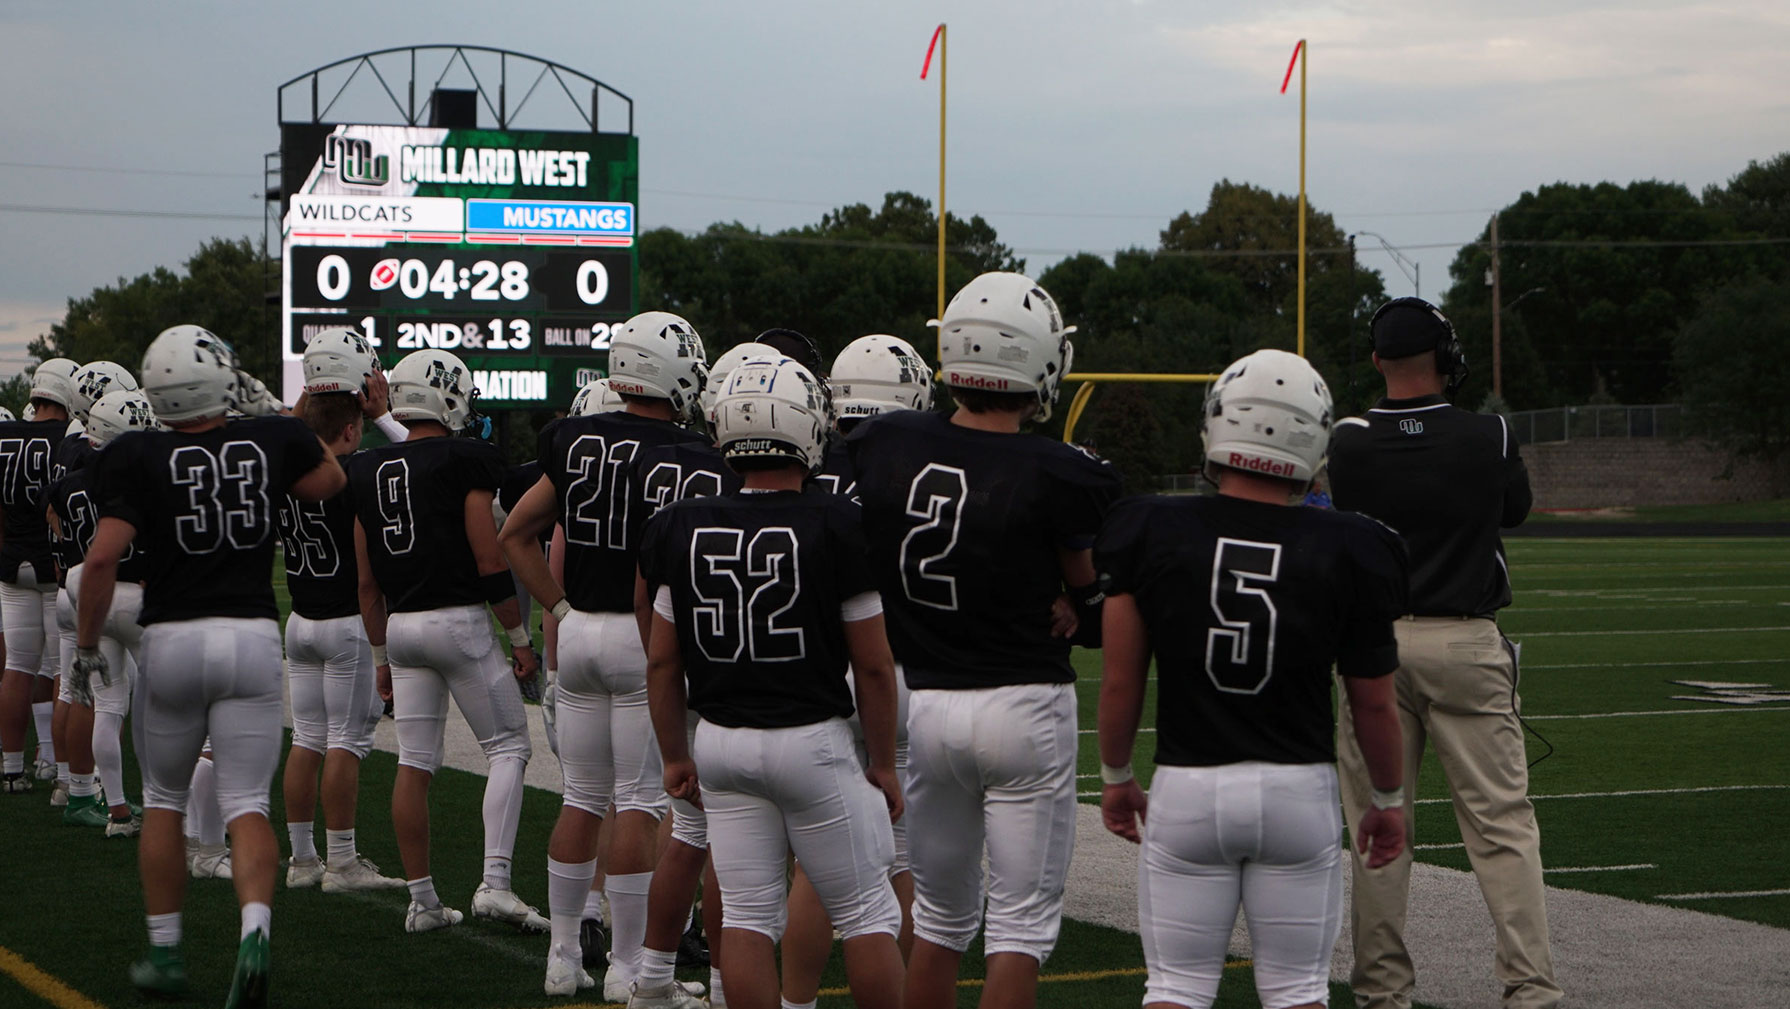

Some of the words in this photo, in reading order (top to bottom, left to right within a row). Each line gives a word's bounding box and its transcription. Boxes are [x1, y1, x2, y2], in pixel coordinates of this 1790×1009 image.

[401, 145, 517, 185] MILLARD
[518, 149, 591, 187] WEST
[299, 203, 413, 223] WILDCATS
[503, 206, 627, 230] MUSTANGS
[316, 254, 351, 300] 0
[399, 258, 530, 300] 04:28
[576, 259, 609, 305] 0
[360, 316, 382, 347] 1
[545, 328, 573, 346] BALL
[574, 328, 591, 347] ON
[307, 382, 340, 393] Riddell
[608, 381, 644, 394] Riddell
[950, 372, 1008, 390] Riddell
[844, 404, 880, 415] schutt
[734, 439, 773, 451] schutt
[1229, 452, 1295, 477] Riddell
[168, 439, 271, 555] 33
[376, 457, 416, 556] 9
[565, 434, 640, 550] 21
[899, 462, 969, 612] 2
[689, 526, 806, 664] 52
[1204, 536, 1283, 695] 5
